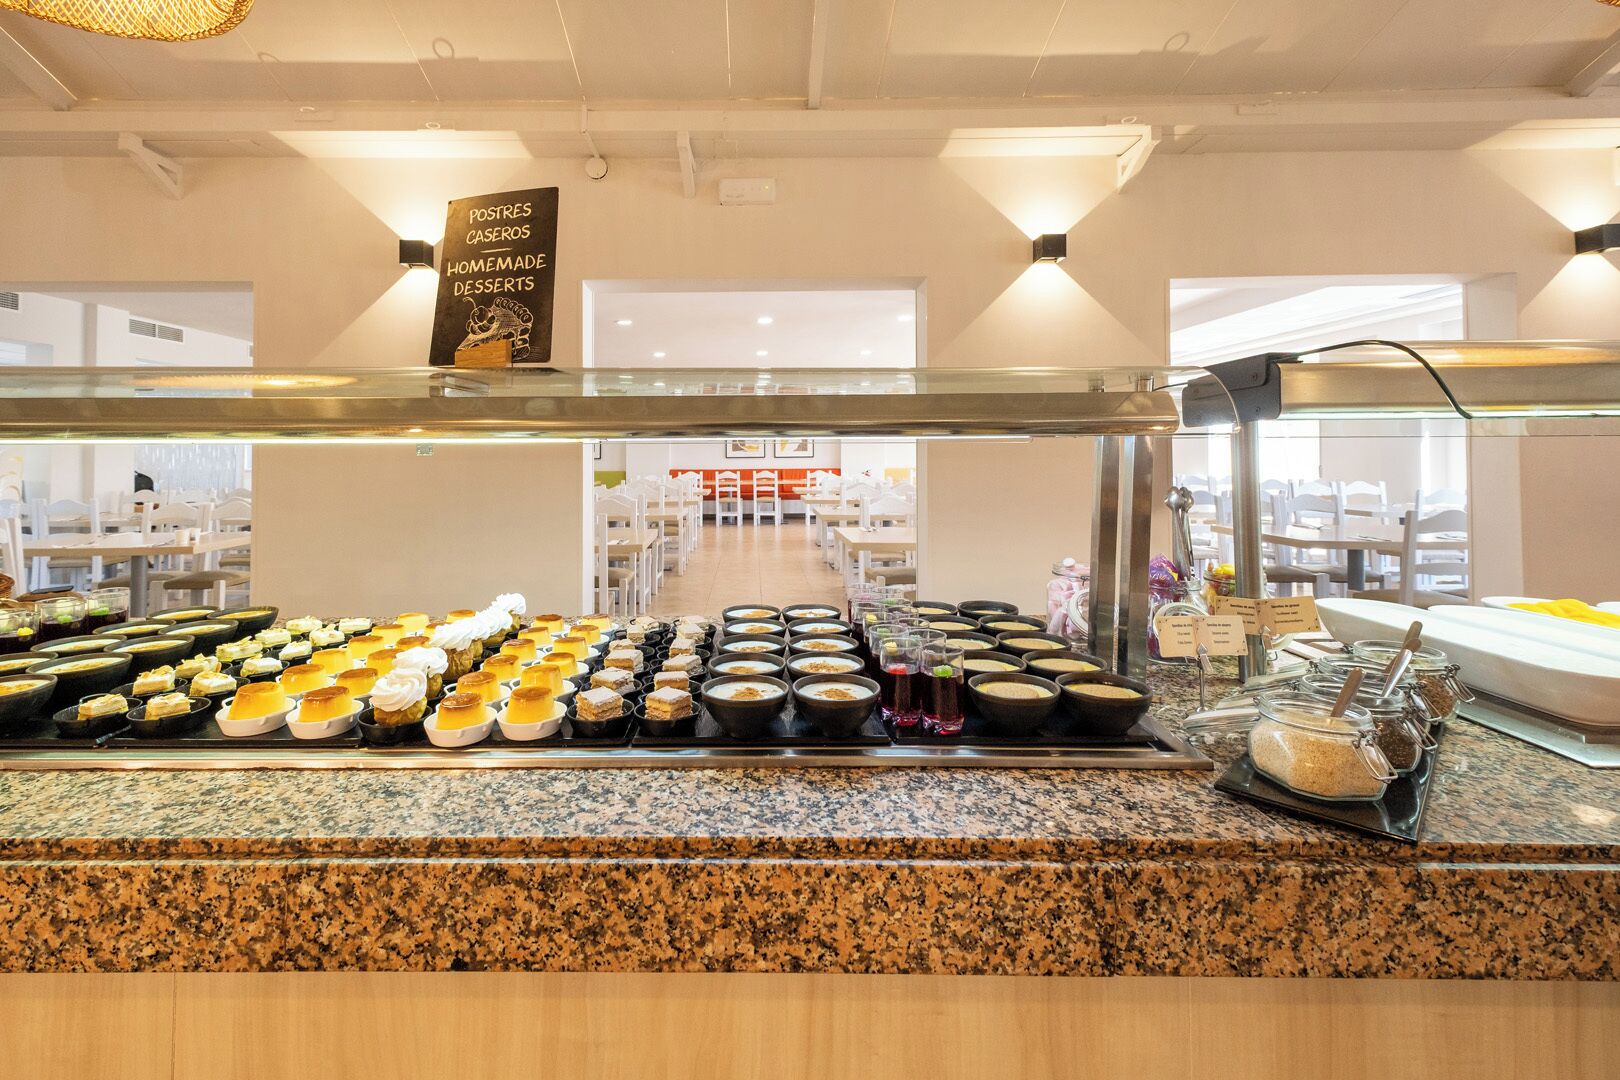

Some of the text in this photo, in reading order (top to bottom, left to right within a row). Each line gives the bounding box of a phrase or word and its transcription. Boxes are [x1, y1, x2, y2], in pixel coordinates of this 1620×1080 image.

[469, 202, 532, 224] POSTRES
[466, 225, 531, 245] CASEROS
[447, 253, 547, 277] HOMEMADE
[454, 276, 535, 296] DESSERTS
